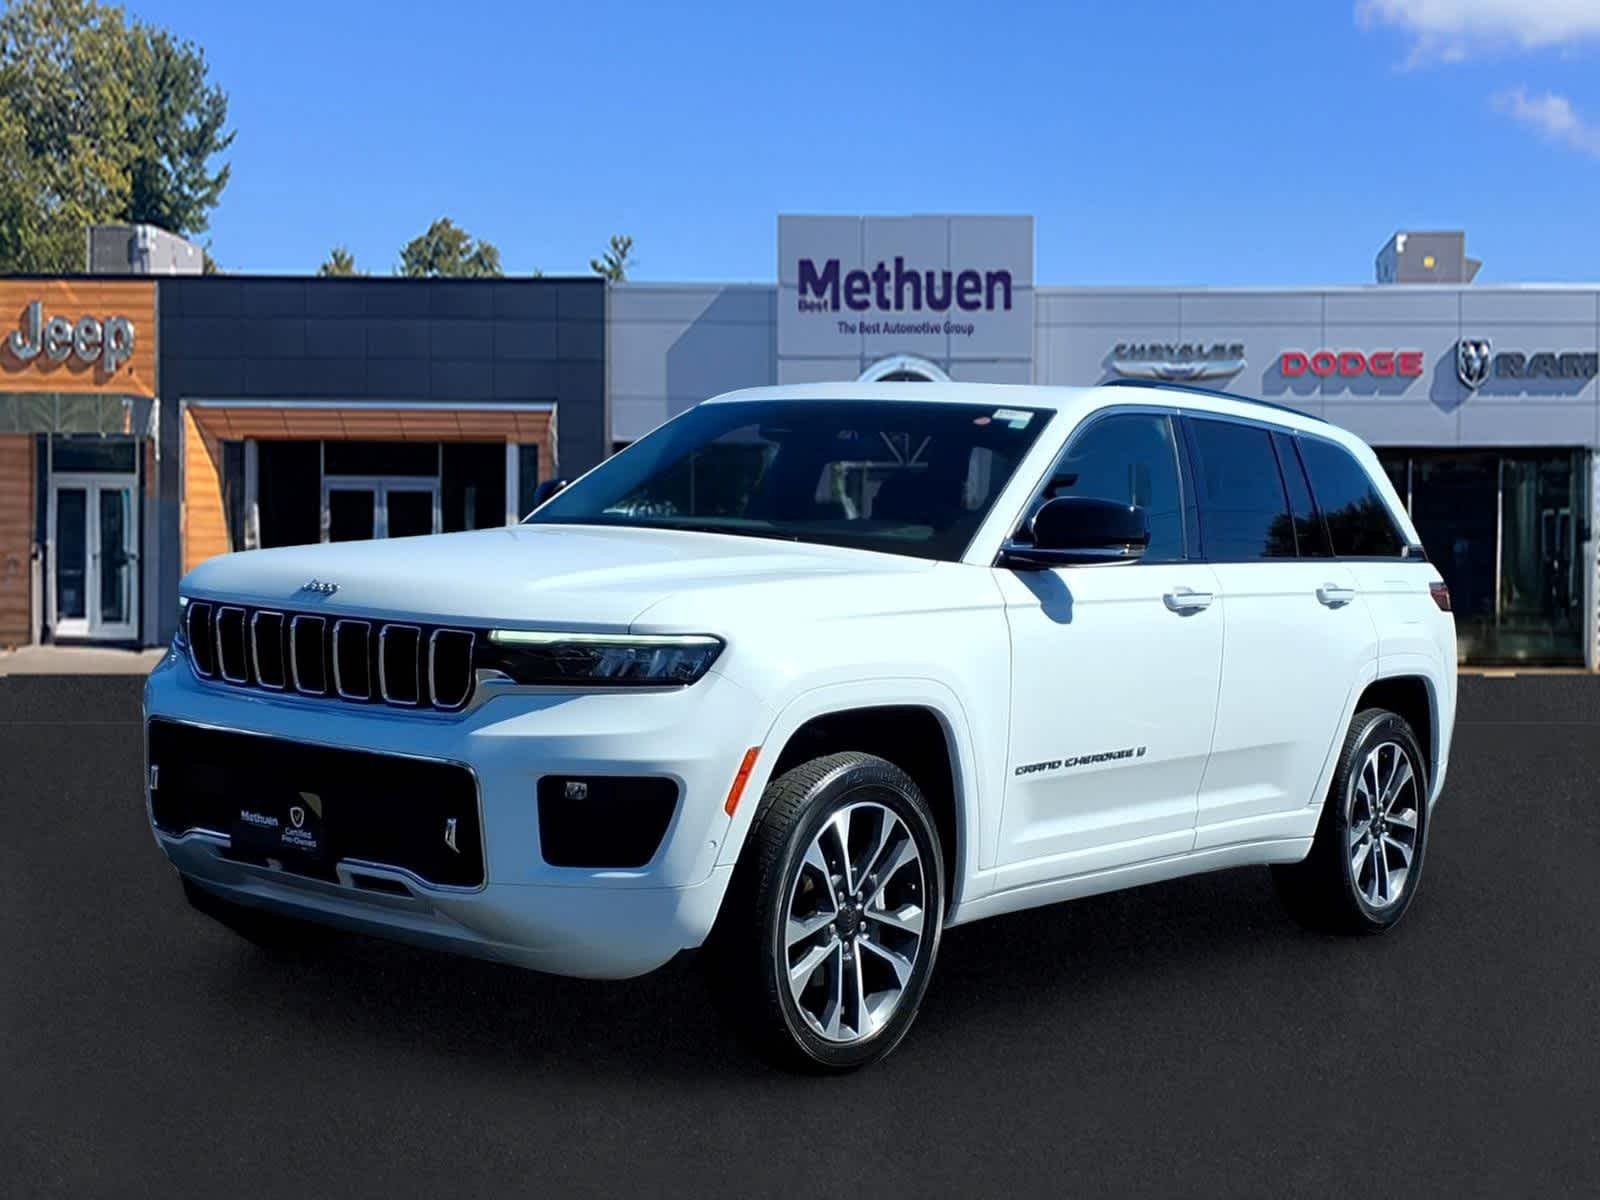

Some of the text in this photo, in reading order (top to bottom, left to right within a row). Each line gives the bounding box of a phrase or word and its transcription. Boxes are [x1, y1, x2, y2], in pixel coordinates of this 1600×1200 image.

[798, 257, 1012, 312] Methuen
[798, 299, 829, 312] Best
[10, 300, 135, 373] Jeep
[838, 321, 974, 339] The Best Automotive Group
[1113, 343, 1245, 360] CHRYSLER
[1281, 351, 1424, 377] DODGE
[1495, 352, 1599, 378] RAM
[1015, 749, 1134, 776] GRAND CHEROKEE
[241, 810, 278, 826] Methuen
